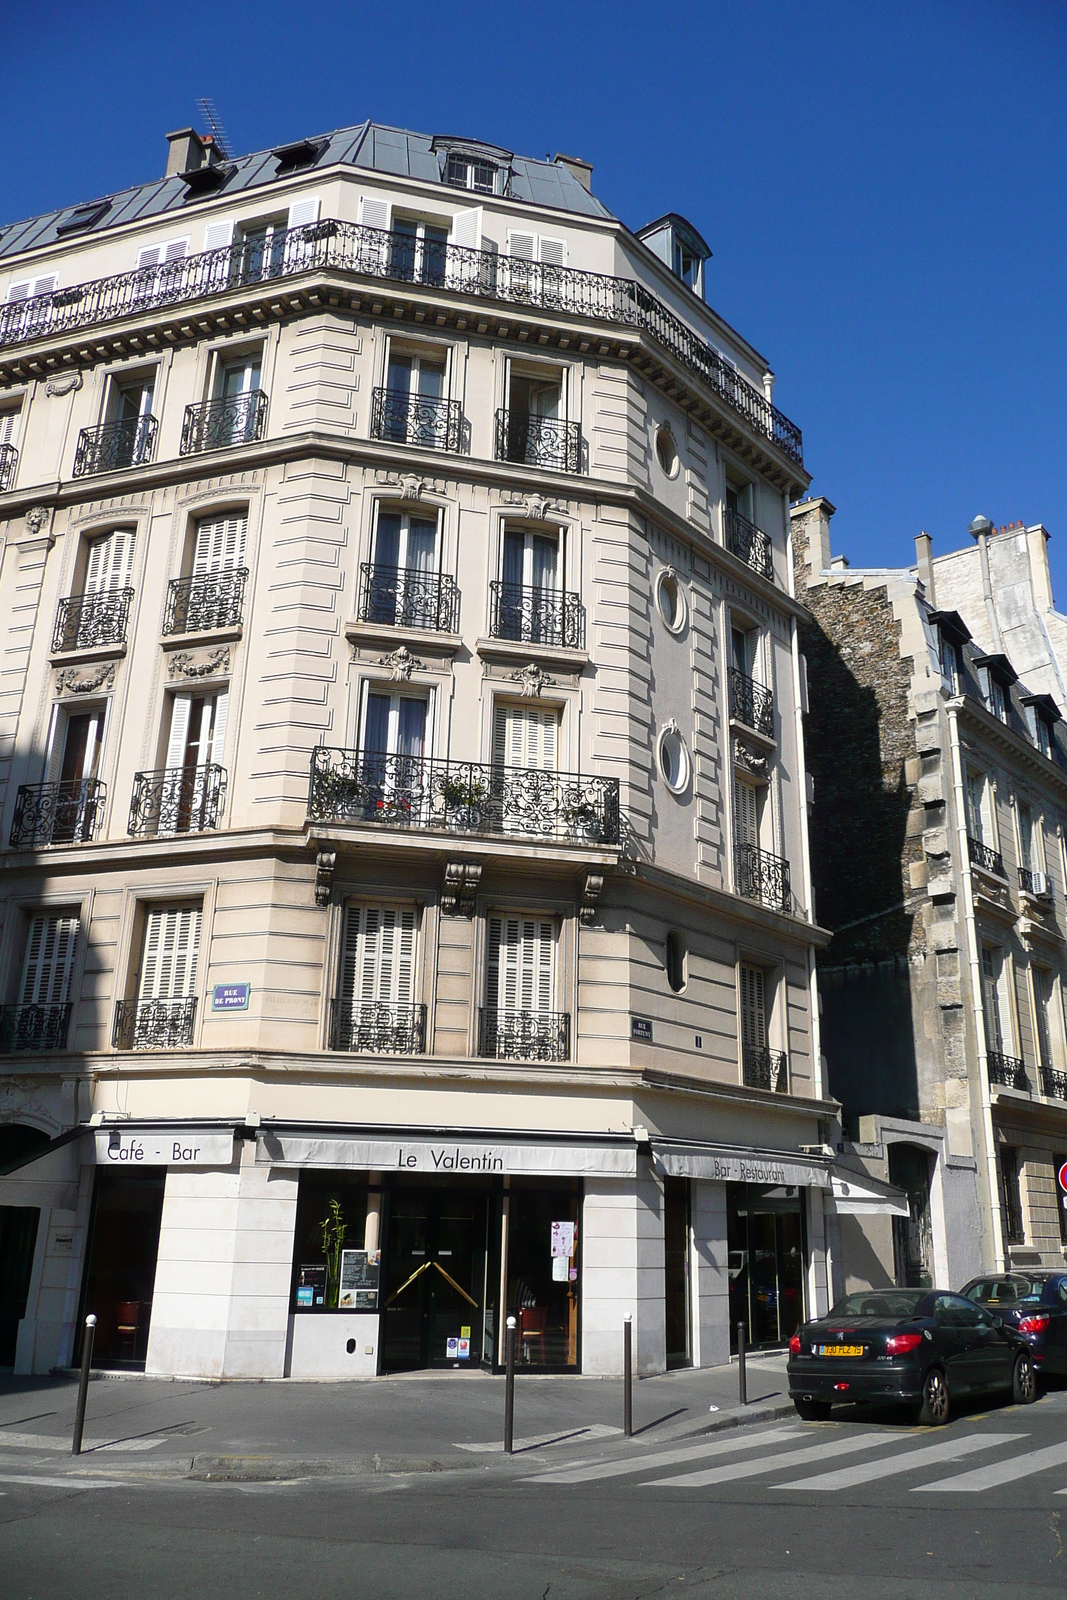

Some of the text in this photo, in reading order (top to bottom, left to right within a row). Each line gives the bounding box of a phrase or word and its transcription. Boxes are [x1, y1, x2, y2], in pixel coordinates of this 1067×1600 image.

[225, 996, 246, 1004] PRONY
[107, 1139, 144, 1161] Café
[172, 1142, 201, 1161] Bar
[398, 1148, 503, 1170] Le Valentin
[714, 1160, 731, 1177] Bar
[740, 1162, 785, 1181] Restaurant
